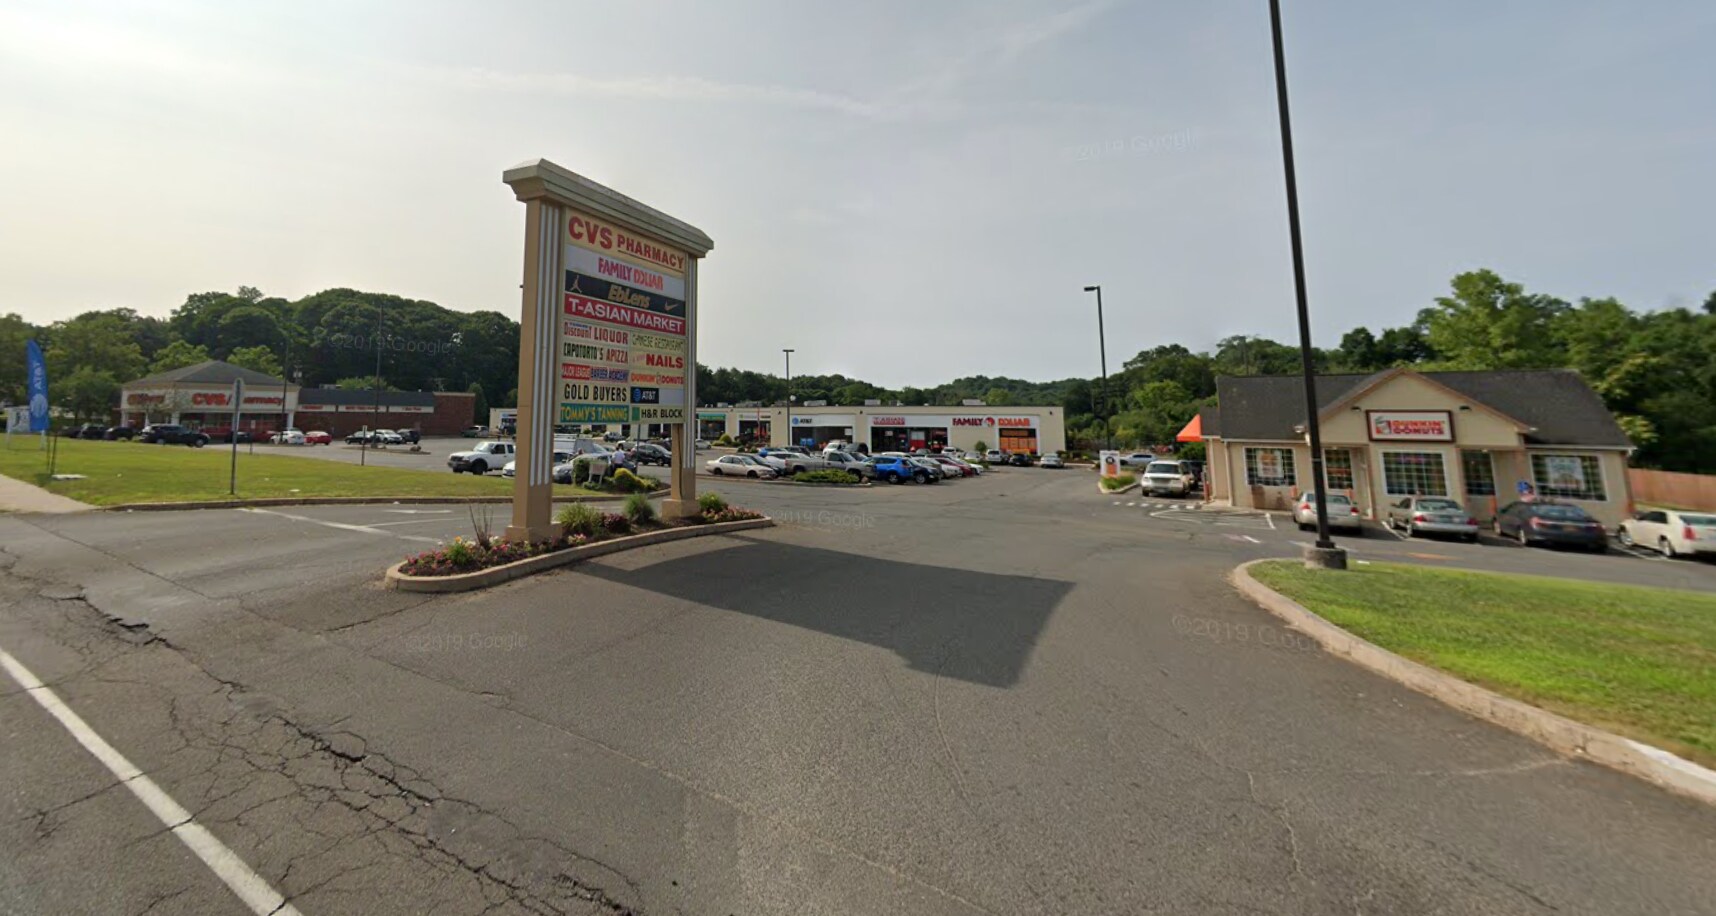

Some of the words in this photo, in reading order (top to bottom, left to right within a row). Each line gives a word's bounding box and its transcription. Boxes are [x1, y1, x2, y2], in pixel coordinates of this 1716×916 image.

[568, 216, 613, 249] CVS
[617, 234, 685, 269] PHARMACY
[598, 257, 632, 283] FAMILY
[568, 298, 631, 323] T-ASIAN
[634, 312, 683, 333] MARKET
[594, 326, 629, 345] LIQUOR
[605, 348, 629, 364] APIZZA
[645, 353, 684, 369] NAILS
[564, 384, 590, 400] GOLD
[593, 386, 627, 402] BUYERS
[641, 390, 656, 401] AT&T
[561, 405, 596, 421] TOMMY'S
[600, 406, 628, 422] TANNING
[641, 407, 658, 419] H&R
[660, 407, 683, 419] BLOCK
[952, 418, 983, 426] FAMILY
